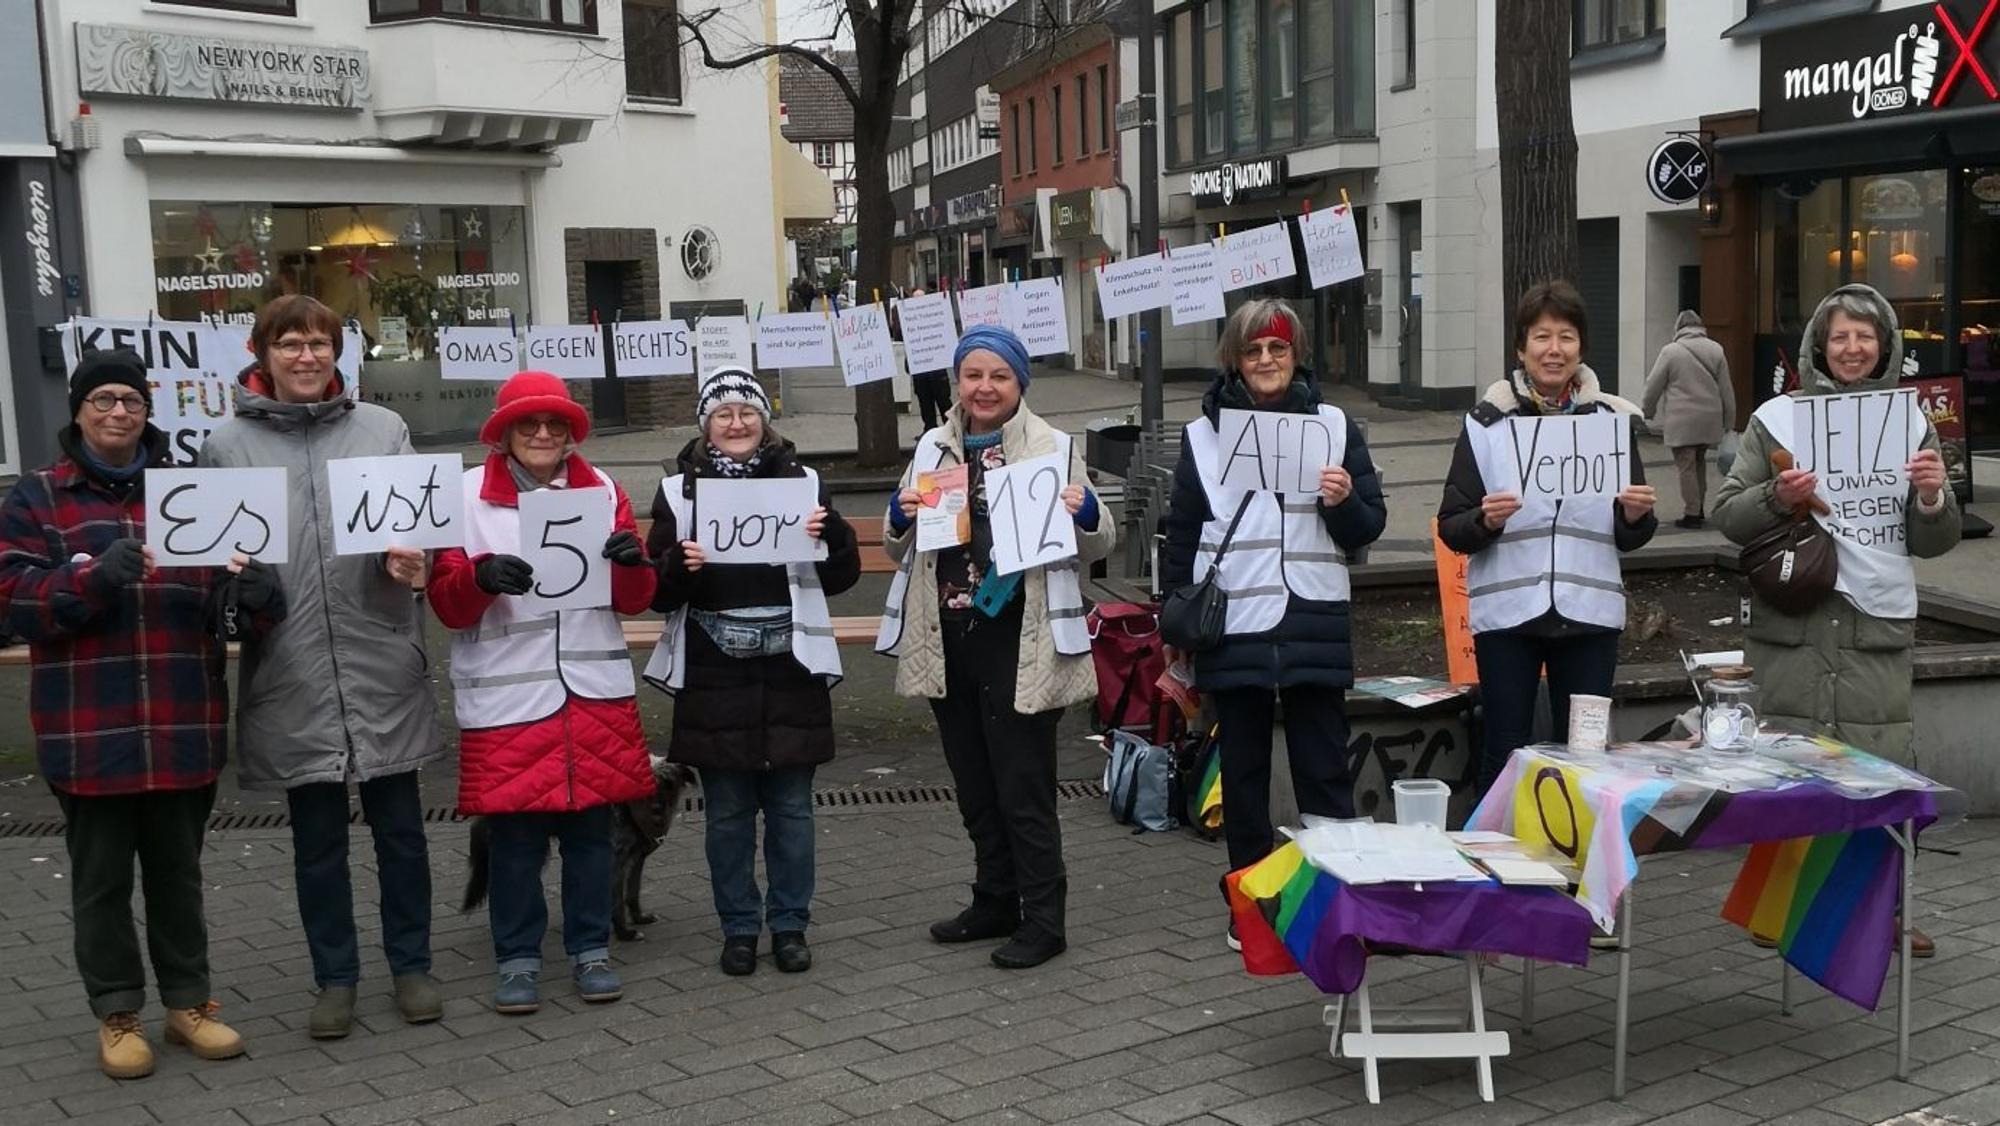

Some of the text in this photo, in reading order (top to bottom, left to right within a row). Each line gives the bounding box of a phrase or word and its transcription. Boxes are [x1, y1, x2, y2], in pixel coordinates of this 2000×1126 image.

[248, 50, 305, 73] YORK
[312, 55, 361, 77] STAR
[1784, 33, 1907, 118] mangal
[230, 82, 340, 99] NAILS & BEAUTY
[1873, 87, 1904, 108] DÖNER
[1190, 160, 1272, 196] SMOKE NATION
[1307, 222, 1347, 243] Herz
[158, 273, 264, 292] NAGELSTUDIO
[437, 272, 520, 289] NAGELSTUDIO
[1105, 268, 1151, 283] Klimaschutz
[1230, 257, 1281, 284] BUNT
[1023, 291, 1050, 301] Gegen
[200, 310, 256, 325] bei uns
[467, 305, 511, 320] bei uns
[1027, 306, 1050, 316] jeden
[761, 324, 826, 334] Menschenrechte
[78, 325, 200, 369] KEIN
[446, 341, 514, 363] OMAS
[530, 336, 597, 361] GEGEN
[616, 330, 689, 361] RECHTS
[176, 371, 239, 418] FÜ
[1794, 390, 1916, 474] JETZT
[1220, 413, 1331, 494] AfD
[1508, 417, 1626, 497] Verbot
[1827, 473, 1897, 492] OMAS
[346, 464, 451, 534] ist
[159, 483, 271, 556] Es
[990, 466, 1065, 563] 12
[708, 513, 801, 553] vor
[534, 515, 589, 599] 5
